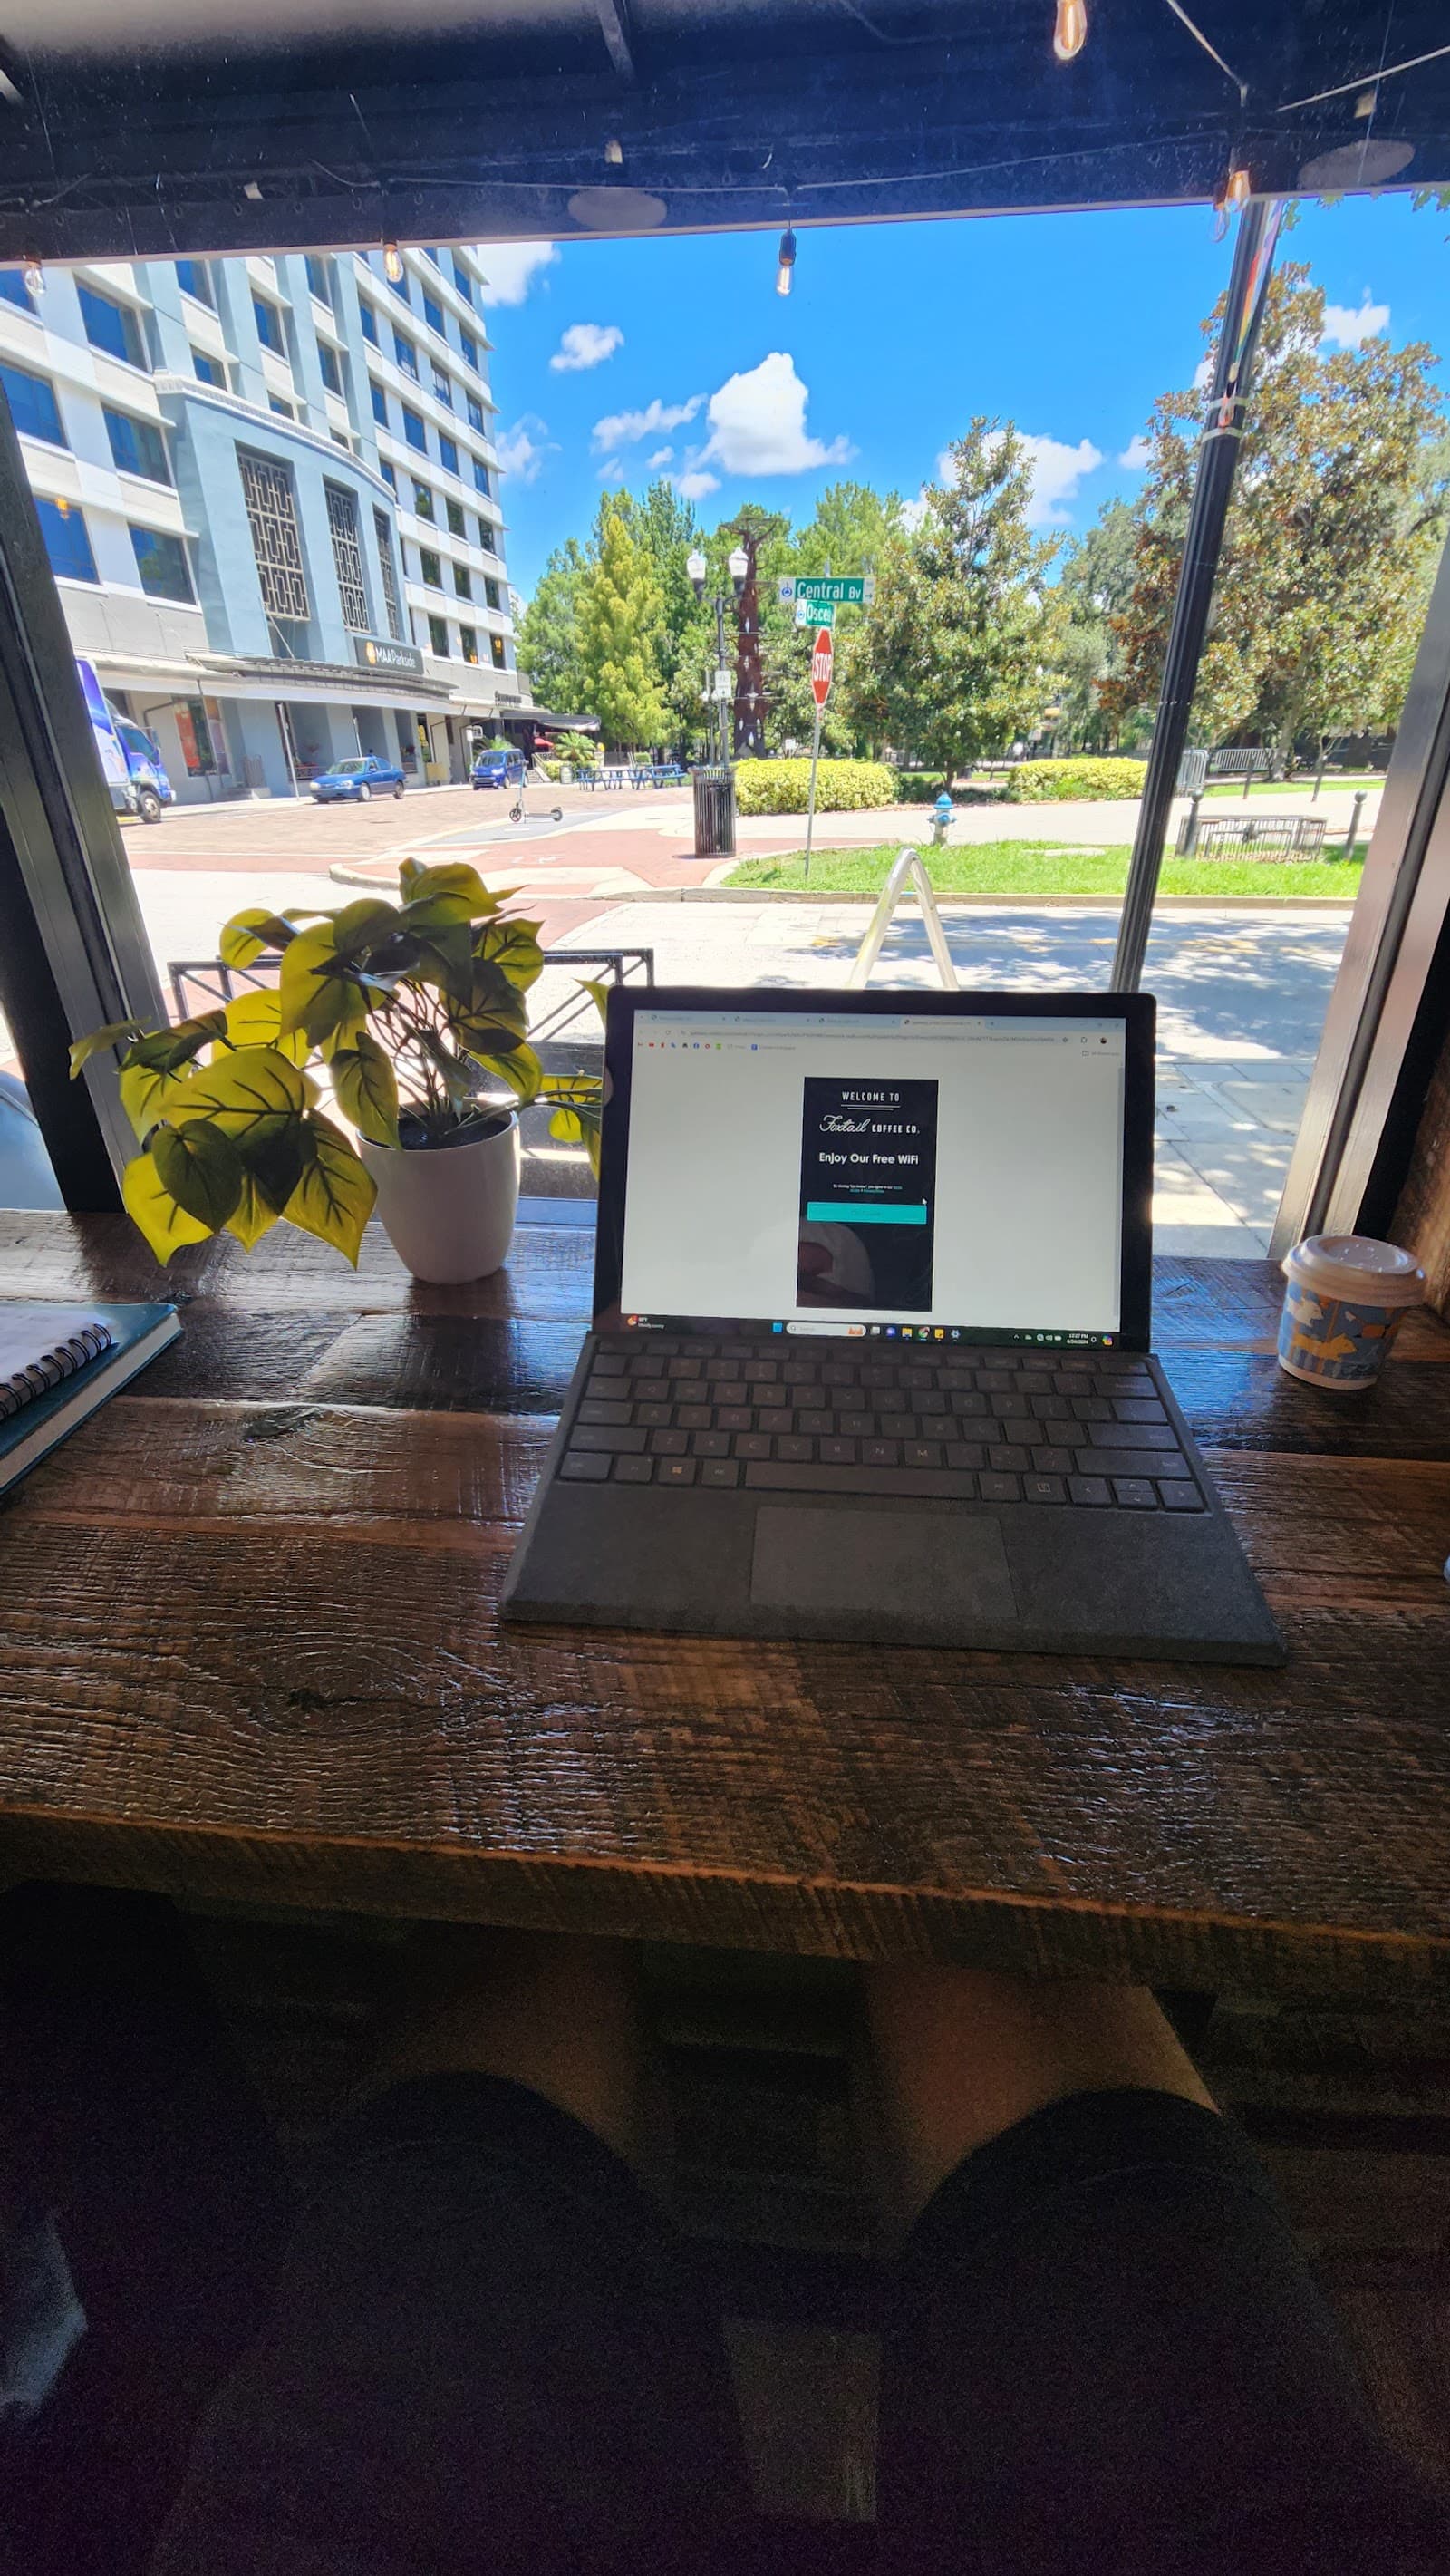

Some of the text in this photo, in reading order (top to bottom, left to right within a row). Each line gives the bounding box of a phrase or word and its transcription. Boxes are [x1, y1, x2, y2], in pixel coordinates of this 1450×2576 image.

[798, 582, 861, 599] Central Bv
[815, 652, 832, 682] STOP
[842, 1091, 900, 1102] WELCOME TO
[819, 1114, 871, 1133] Foxtail
[872, 1124, 902, 1134] COFFEE
[819, 1152, 919, 1165] Enjoy Our Free WiFi
